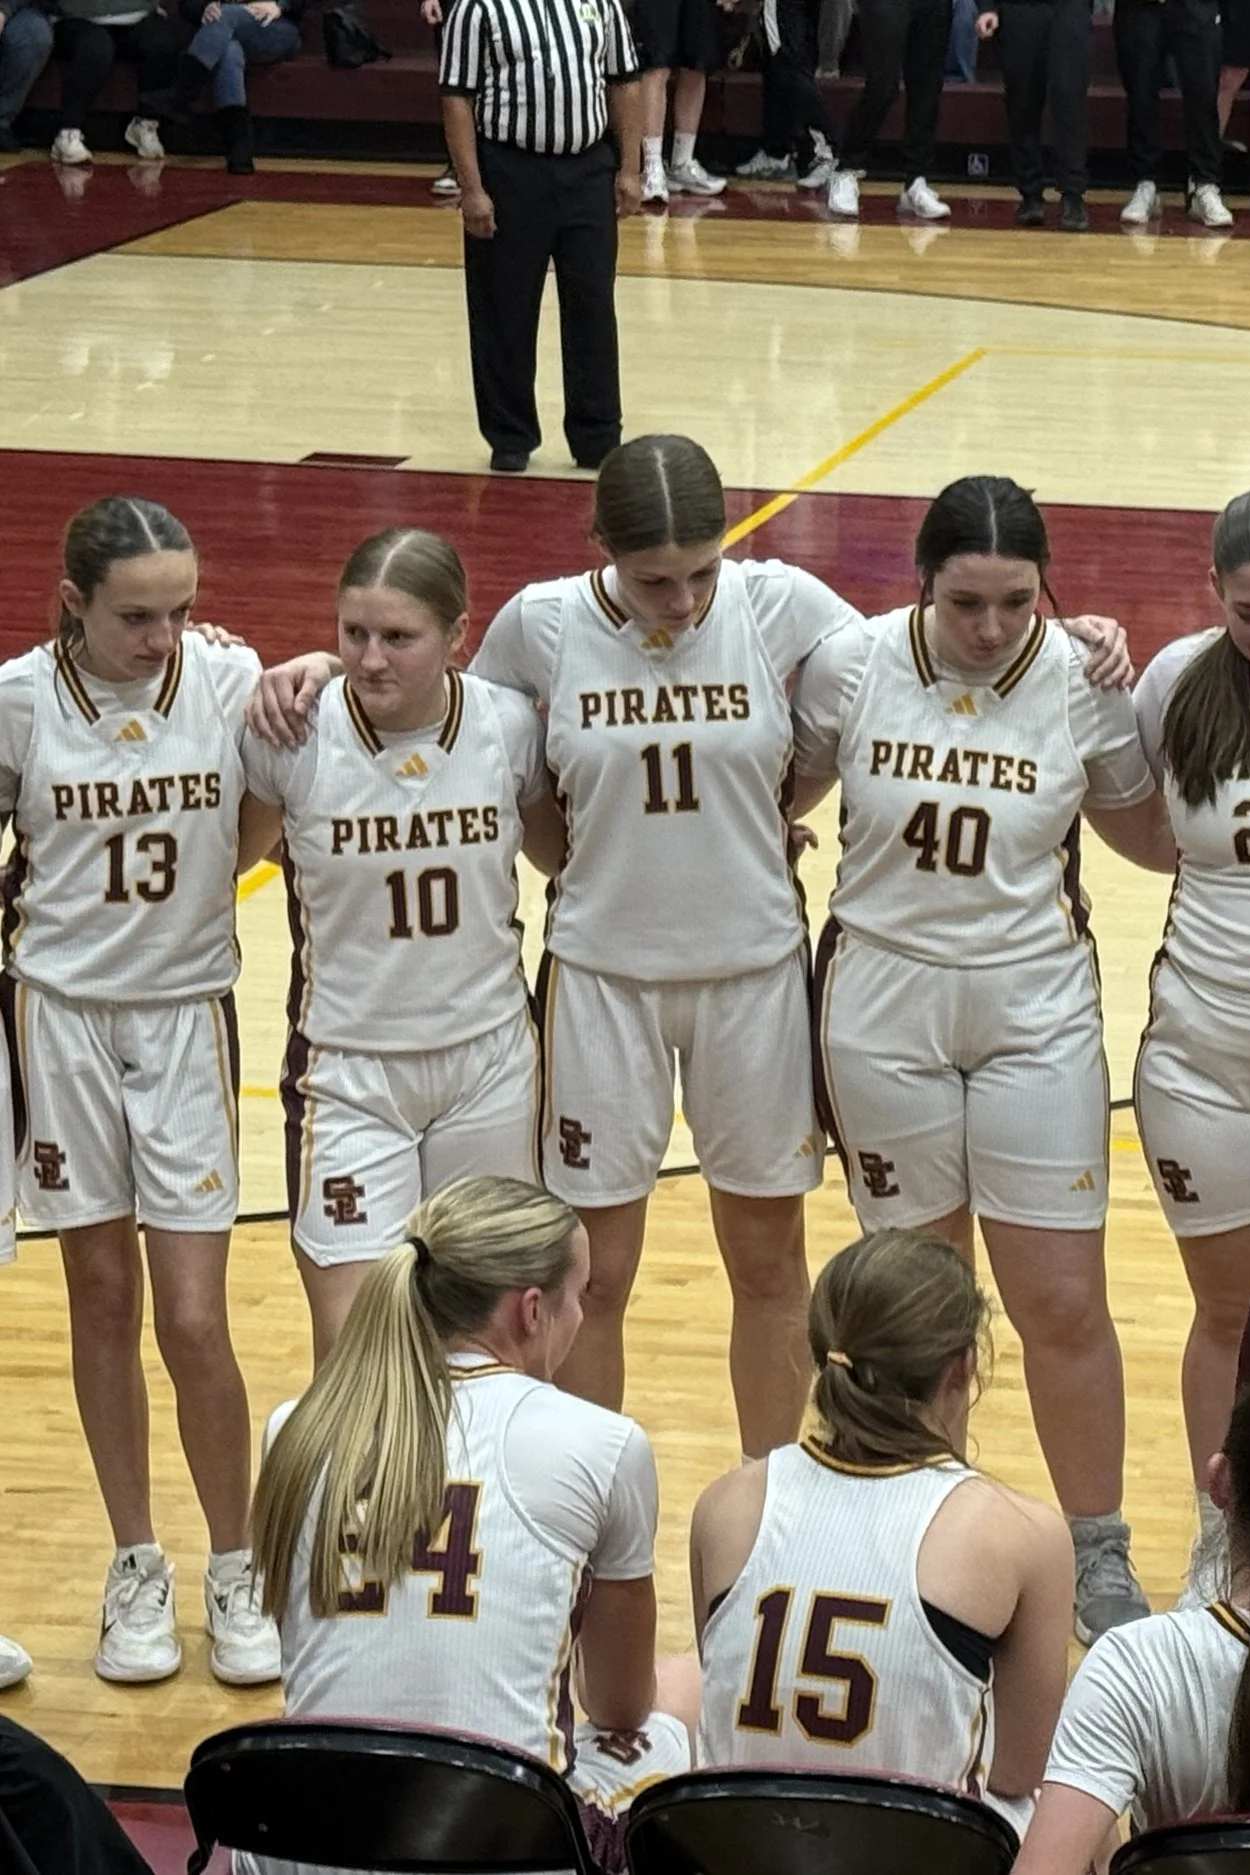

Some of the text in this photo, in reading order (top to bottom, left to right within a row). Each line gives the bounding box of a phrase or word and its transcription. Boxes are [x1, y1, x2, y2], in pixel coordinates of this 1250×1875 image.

[579, 683, 752, 730] PIRATES
[51, 771, 222, 821] PIRATES
[640, 741, 701, 815] 11
[869, 739, 1039, 795] PIRATES
[330, 805, 500, 856] PIRATES
[902, 800, 993, 878] 40
[103, 831, 178, 903] 13
[385, 865, 460, 940] 10
[735, 1584, 895, 1748] 15
